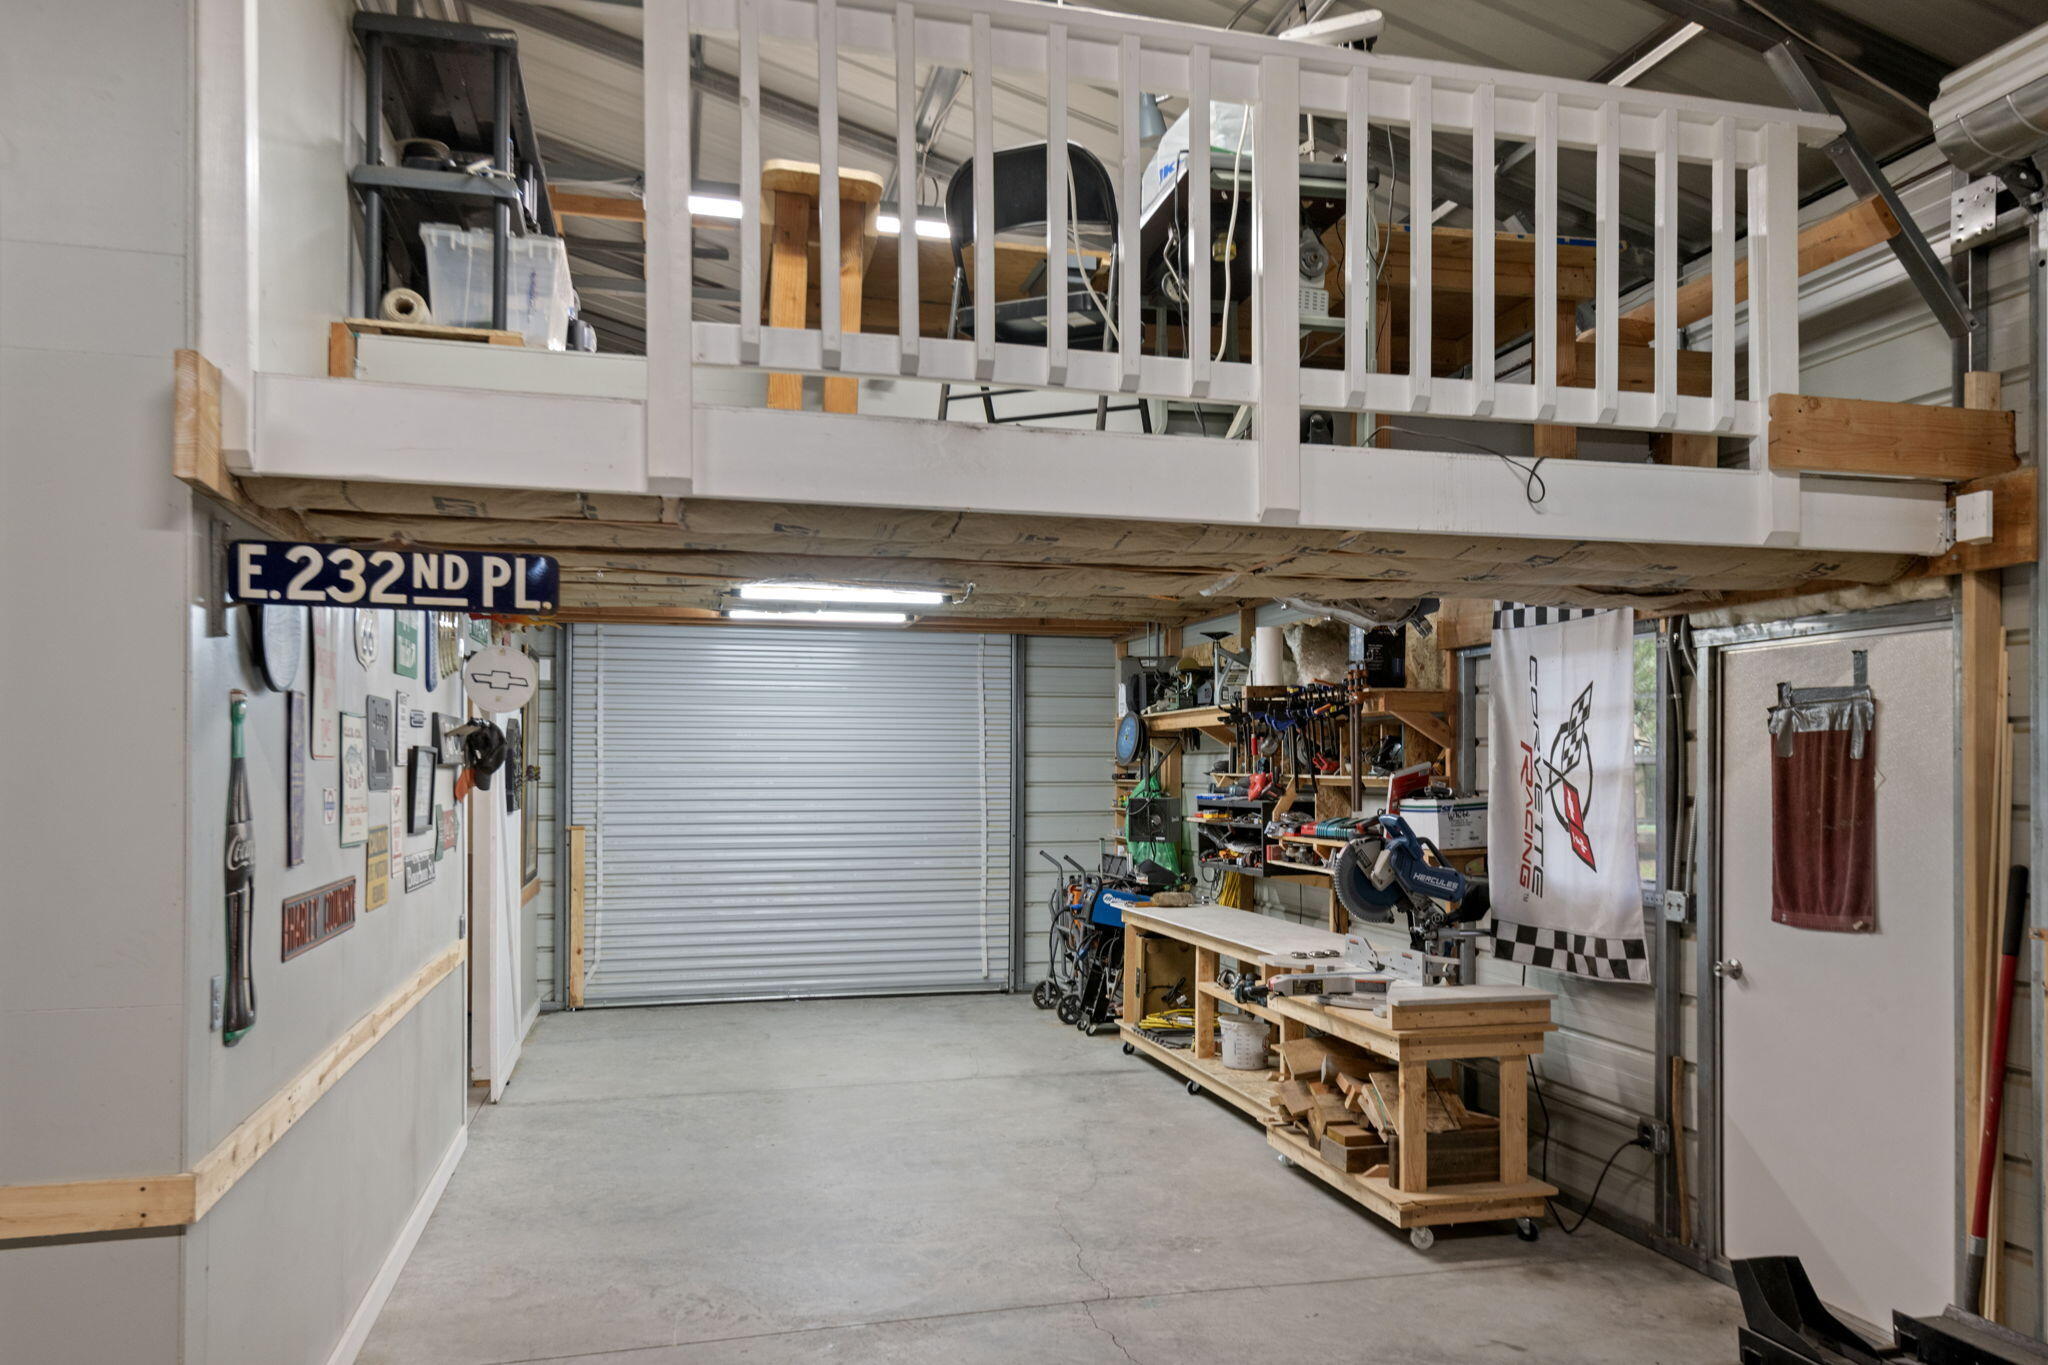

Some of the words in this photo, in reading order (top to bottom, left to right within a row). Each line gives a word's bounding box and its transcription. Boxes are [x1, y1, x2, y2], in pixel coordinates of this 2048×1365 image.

[482, 555, 553, 610] PL.
[372, 707, 389, 735] Jeep
[1529, 655, 1544, 899] CORVETTE
[1519, 740, 1534, 890] RACING
[1412, 872, 1459, 890] HERCULES
